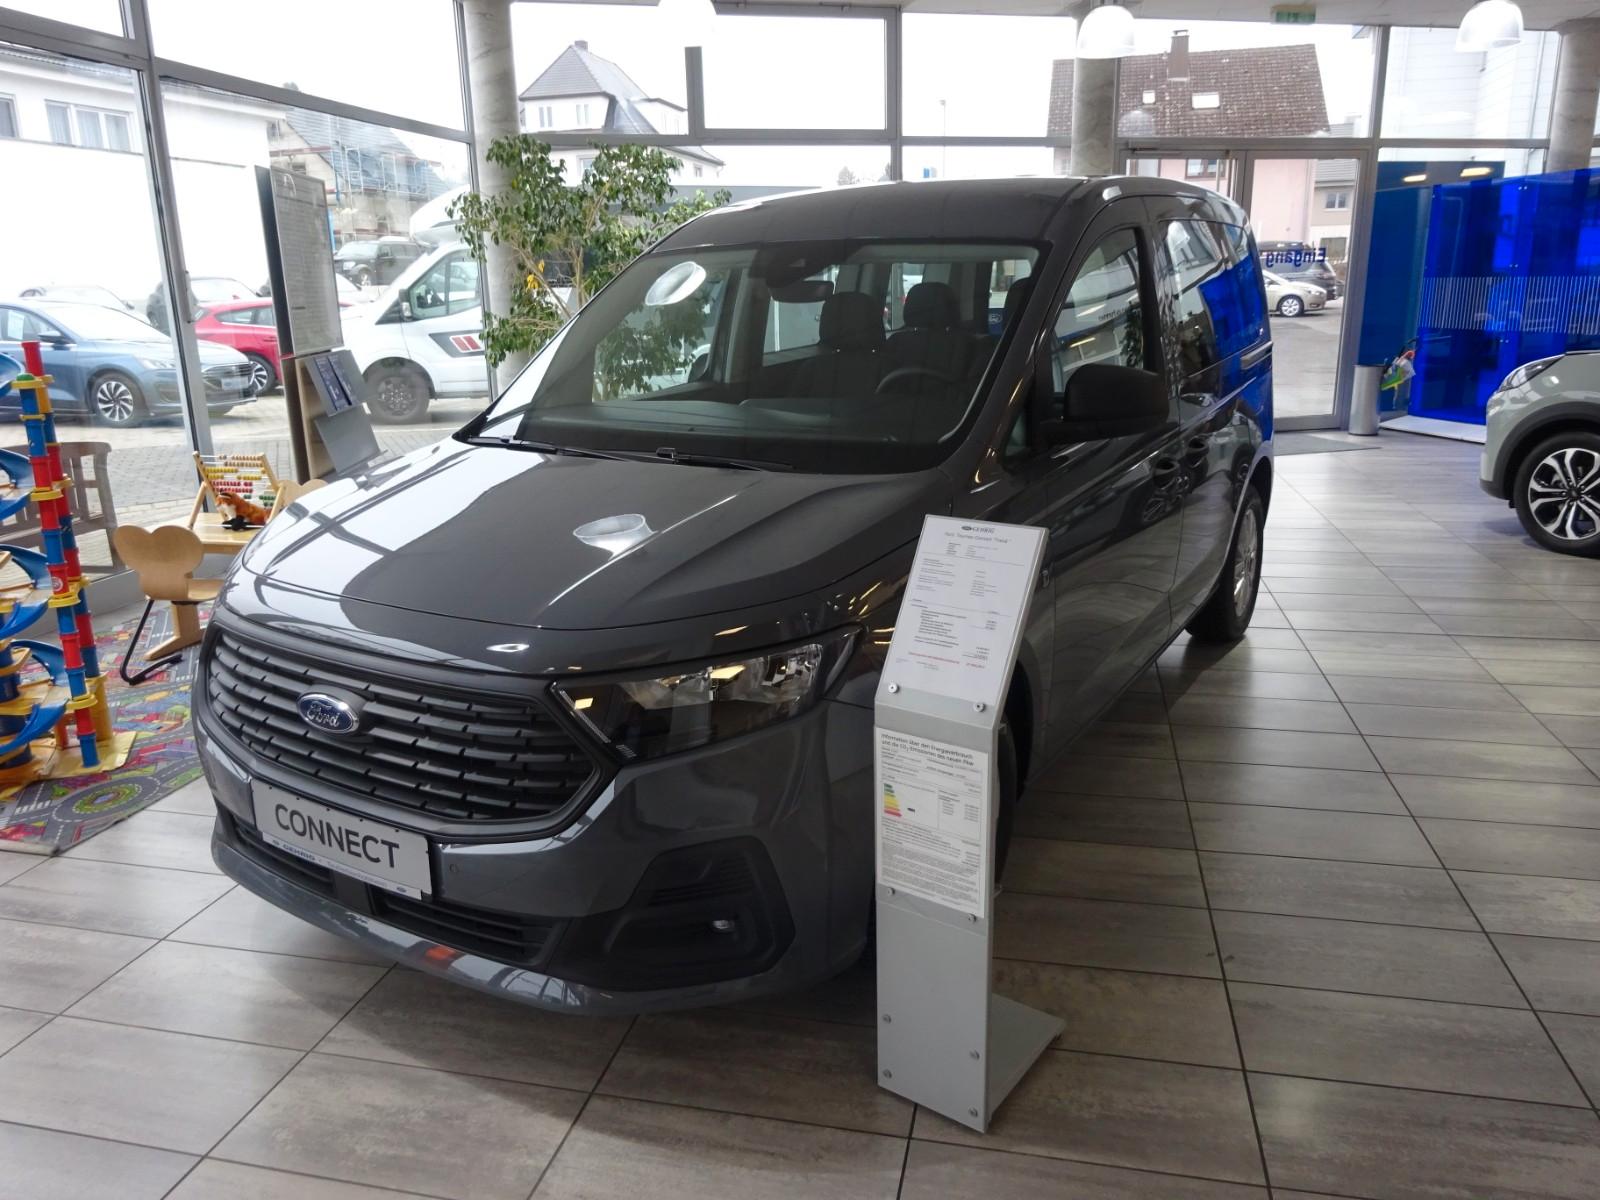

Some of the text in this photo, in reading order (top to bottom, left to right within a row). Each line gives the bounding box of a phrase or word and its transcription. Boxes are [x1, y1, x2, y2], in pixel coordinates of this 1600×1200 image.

[306, 700, 341, 728] Ford
[881, 733, 908, 744] Information
[275, 803, 400, 868] CONNECT
